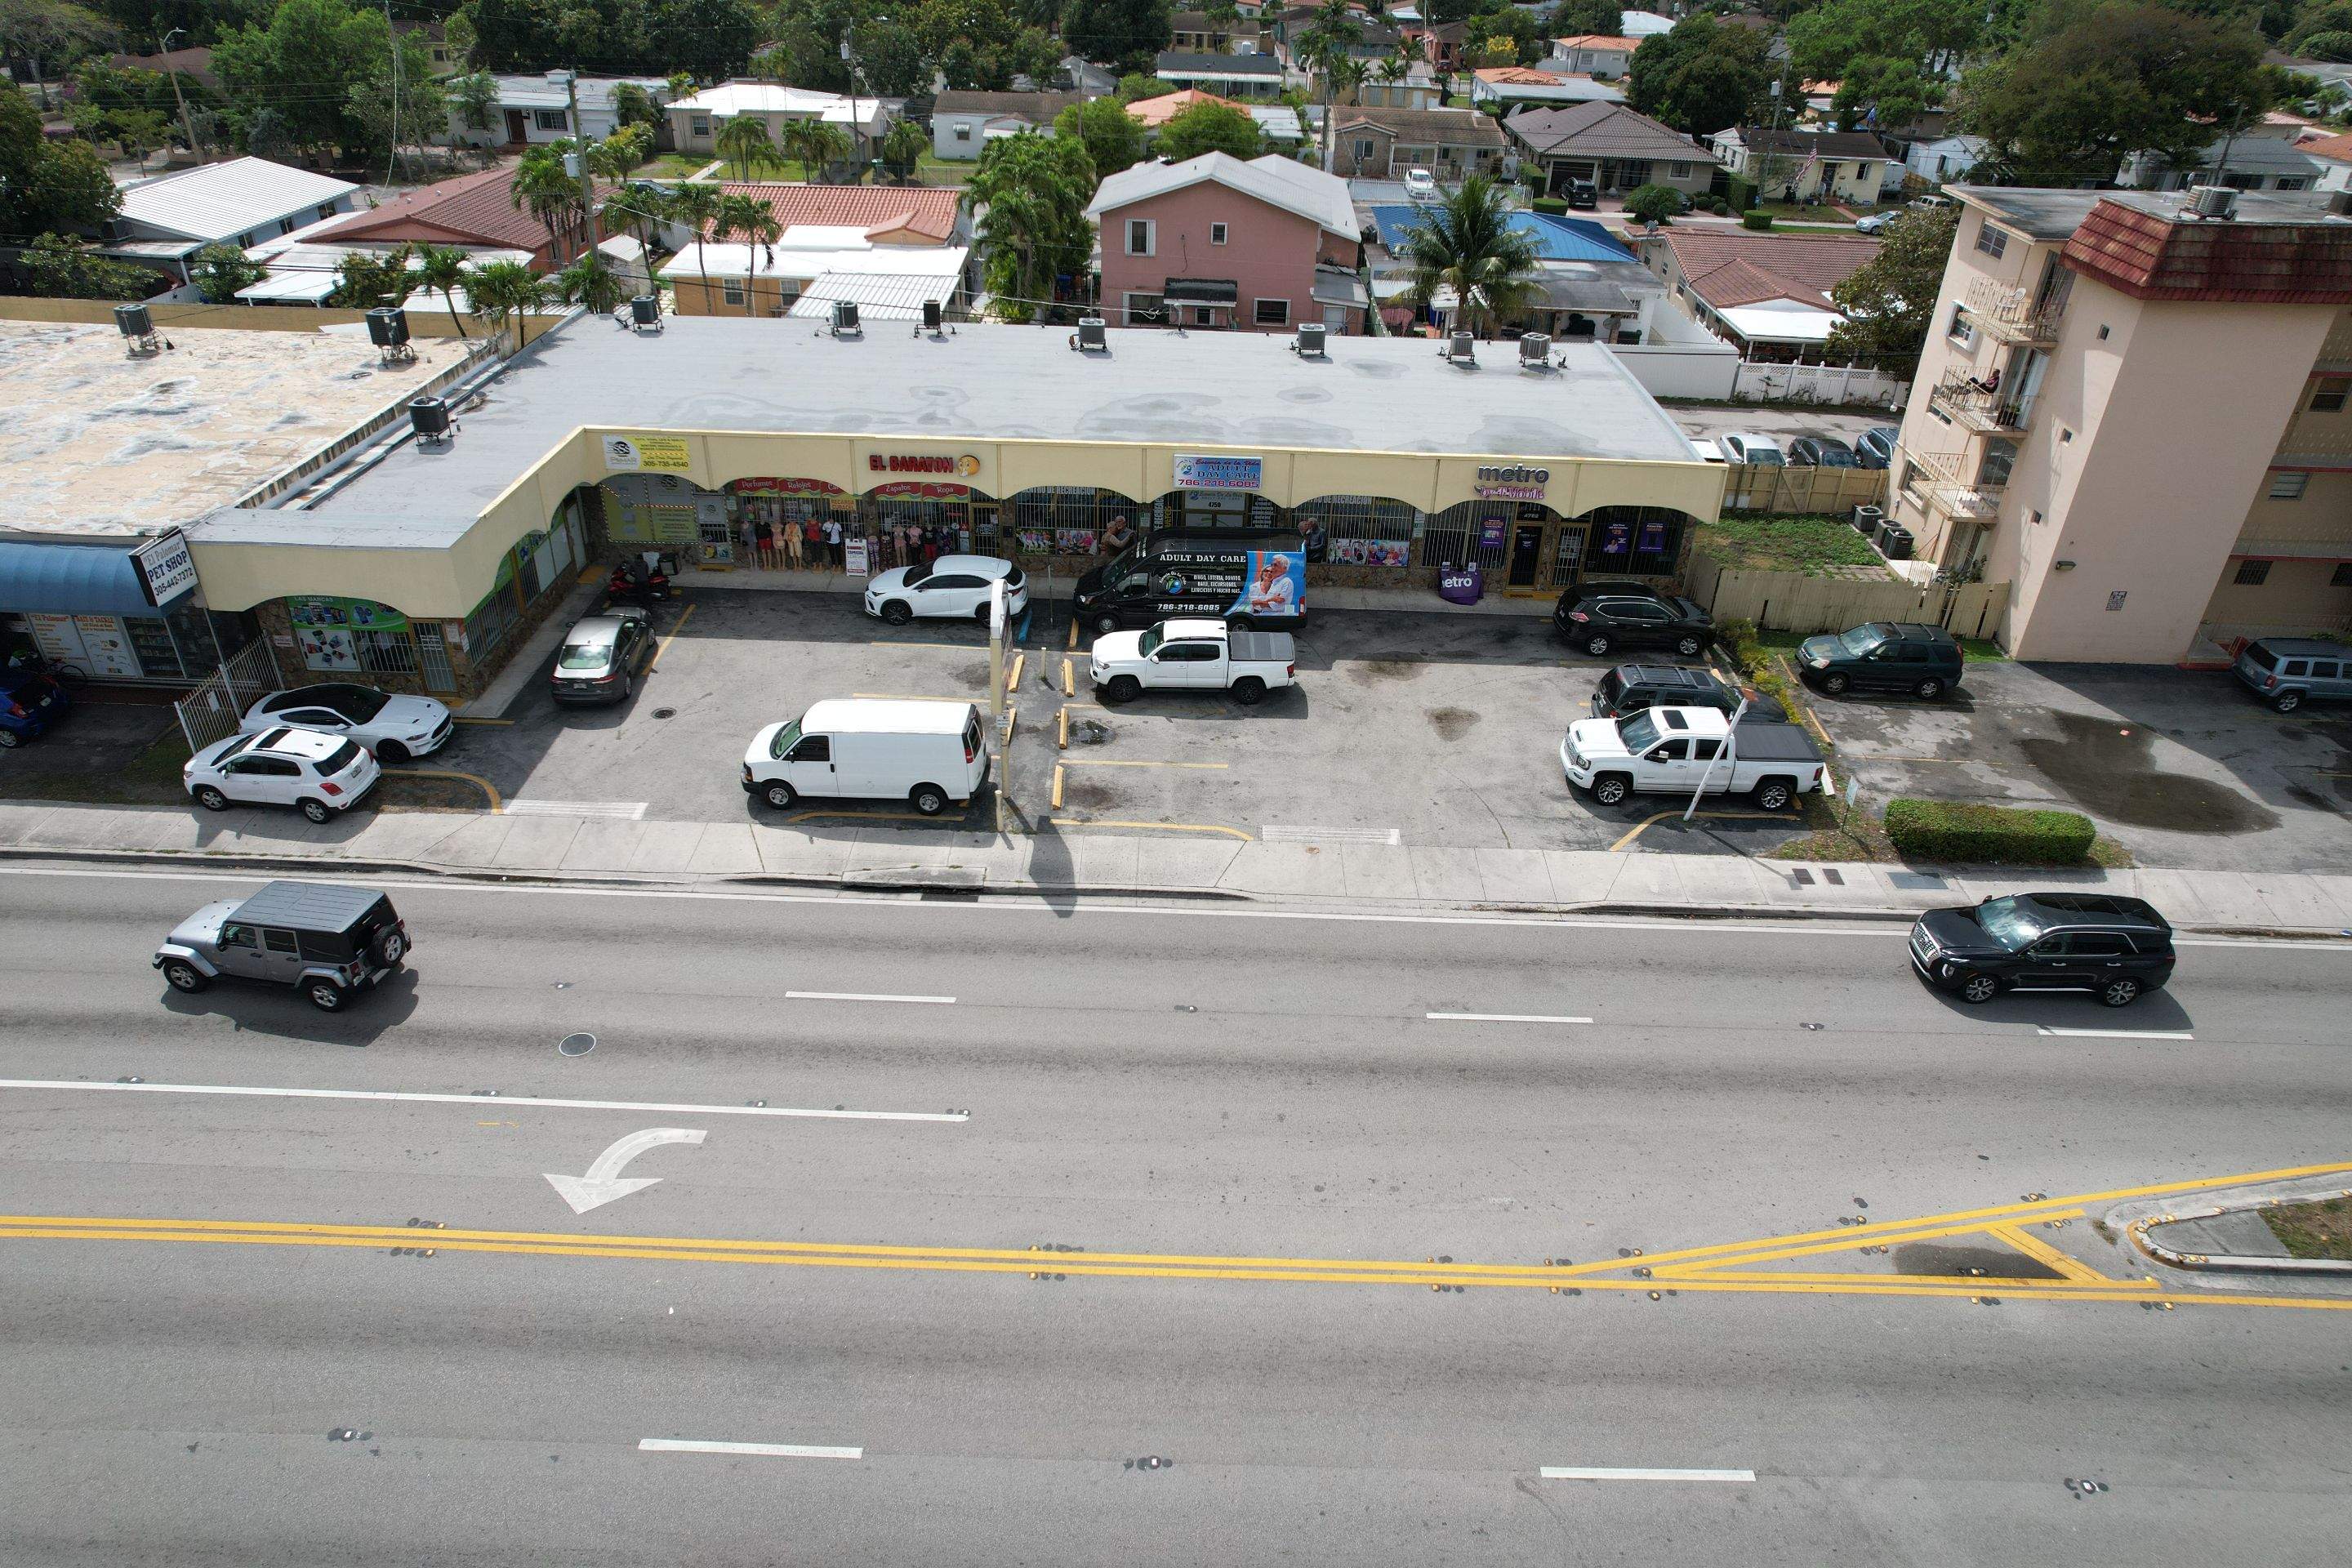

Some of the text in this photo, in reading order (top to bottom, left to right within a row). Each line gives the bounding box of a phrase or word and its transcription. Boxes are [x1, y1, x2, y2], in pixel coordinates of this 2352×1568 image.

[869, 455, 954, 473] EL BARATON
[1478, 463, 1549, 483] metro
[742, 480, 773, 488] Perfumes
[787, 481, 811, 490] Relojes
[885, 484, 911, 493] Zapatos
[937, 485, 954, 494] Ropa
[1160, 554, 1192, 562] ADULT
[147, 550, 187, 582] PET SHOP
[154, 567, 194, 596] 305-442-7372
